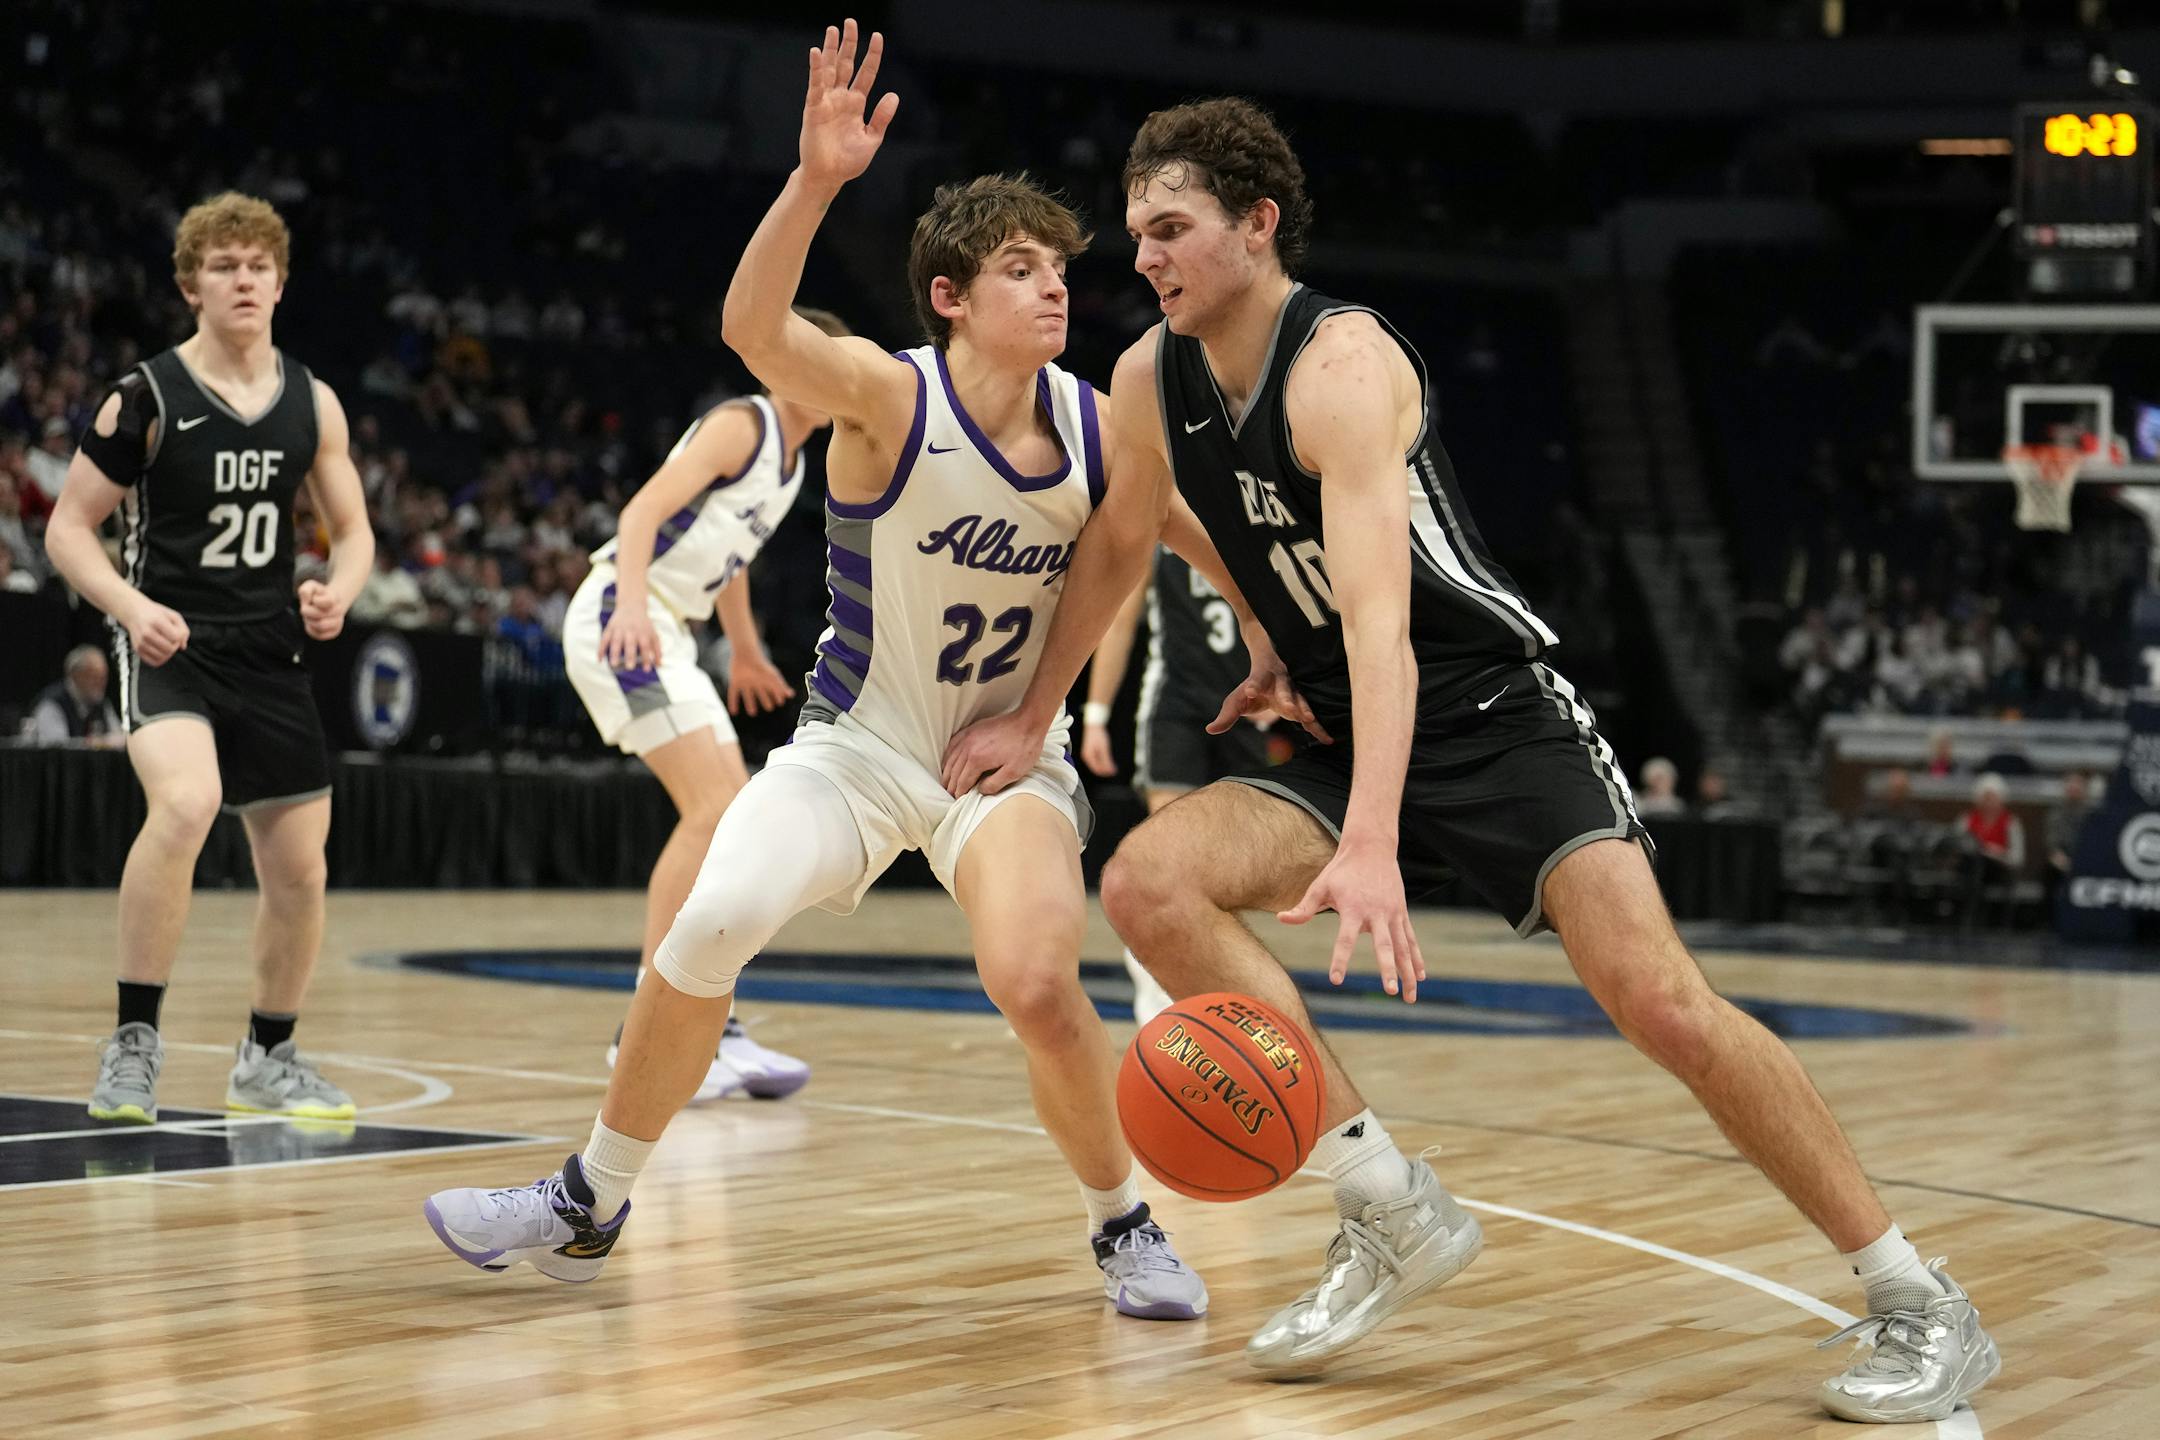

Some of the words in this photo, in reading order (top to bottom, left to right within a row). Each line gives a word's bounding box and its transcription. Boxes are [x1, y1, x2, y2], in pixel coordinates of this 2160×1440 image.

[215, 449, 284, 492] DGF
[200, 502, 279, 568] 20
[1268, 537, 1341, 629] 10
[936, 603, 1033, 687] 22
[1202, 600, 1236, 654] 3
[1155, 1022, 1275, 1136] SPALDING
[1205, 1004, 1299, 1089] LEGACY
